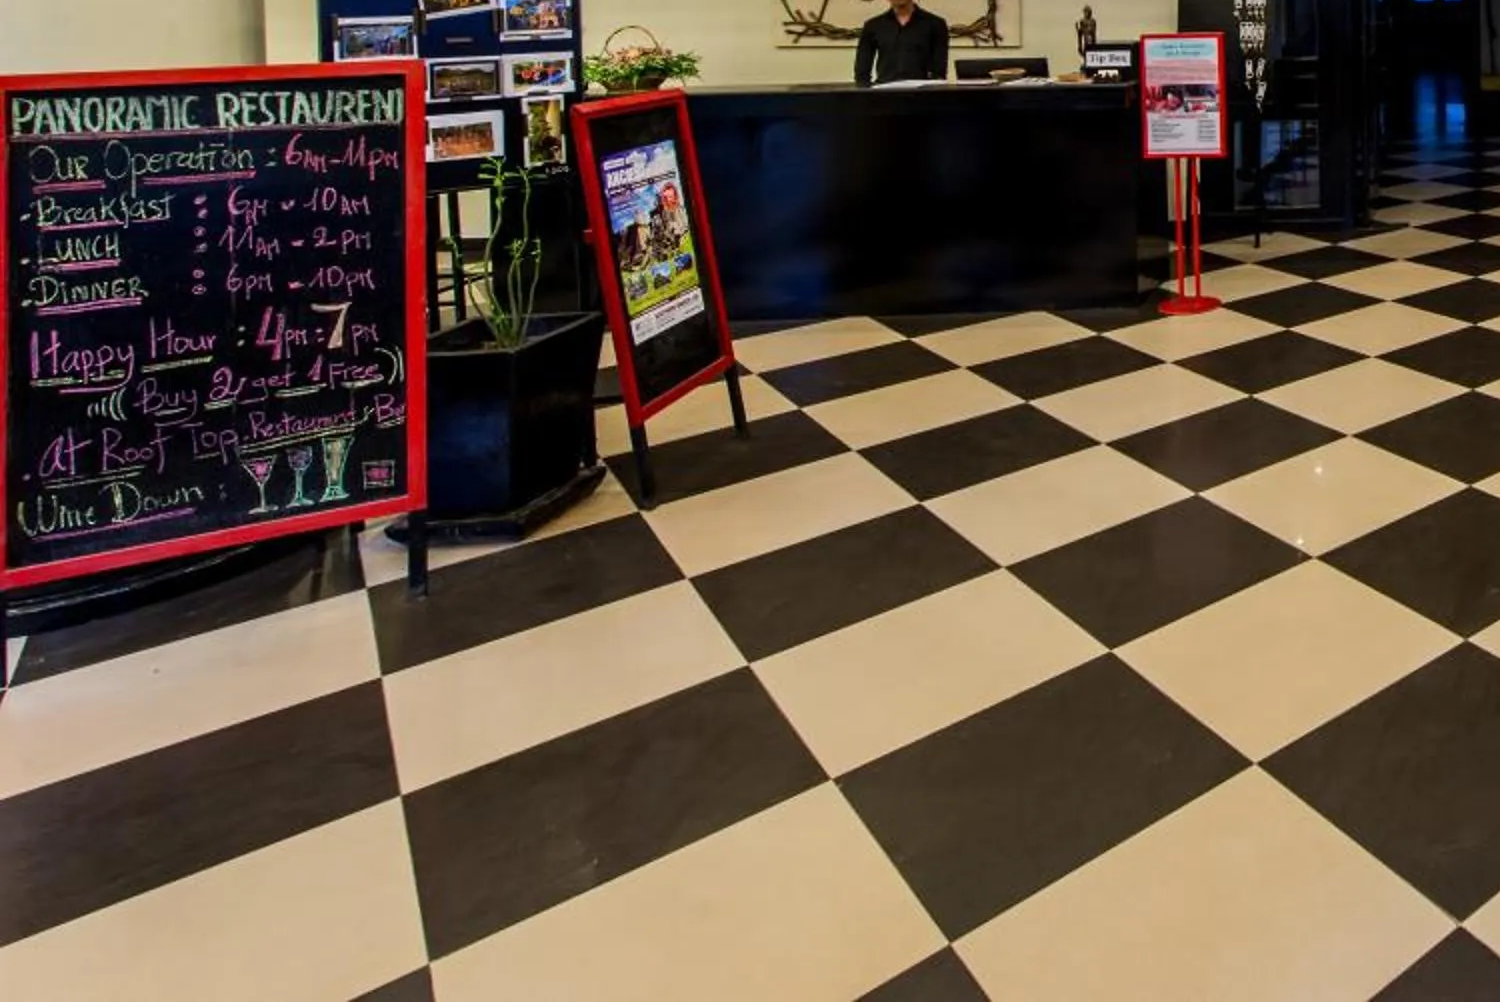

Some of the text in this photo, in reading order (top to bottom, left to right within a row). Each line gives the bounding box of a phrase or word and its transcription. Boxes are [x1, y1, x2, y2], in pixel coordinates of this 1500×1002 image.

[11, 95, 201, 136] PANORAMIC
[35, 192, 177, 229] Breakfast
[30, 330, 136, 393] Happy
[150, 316, 217, 359] Hour
[101, 427, 173, 475] Roof
